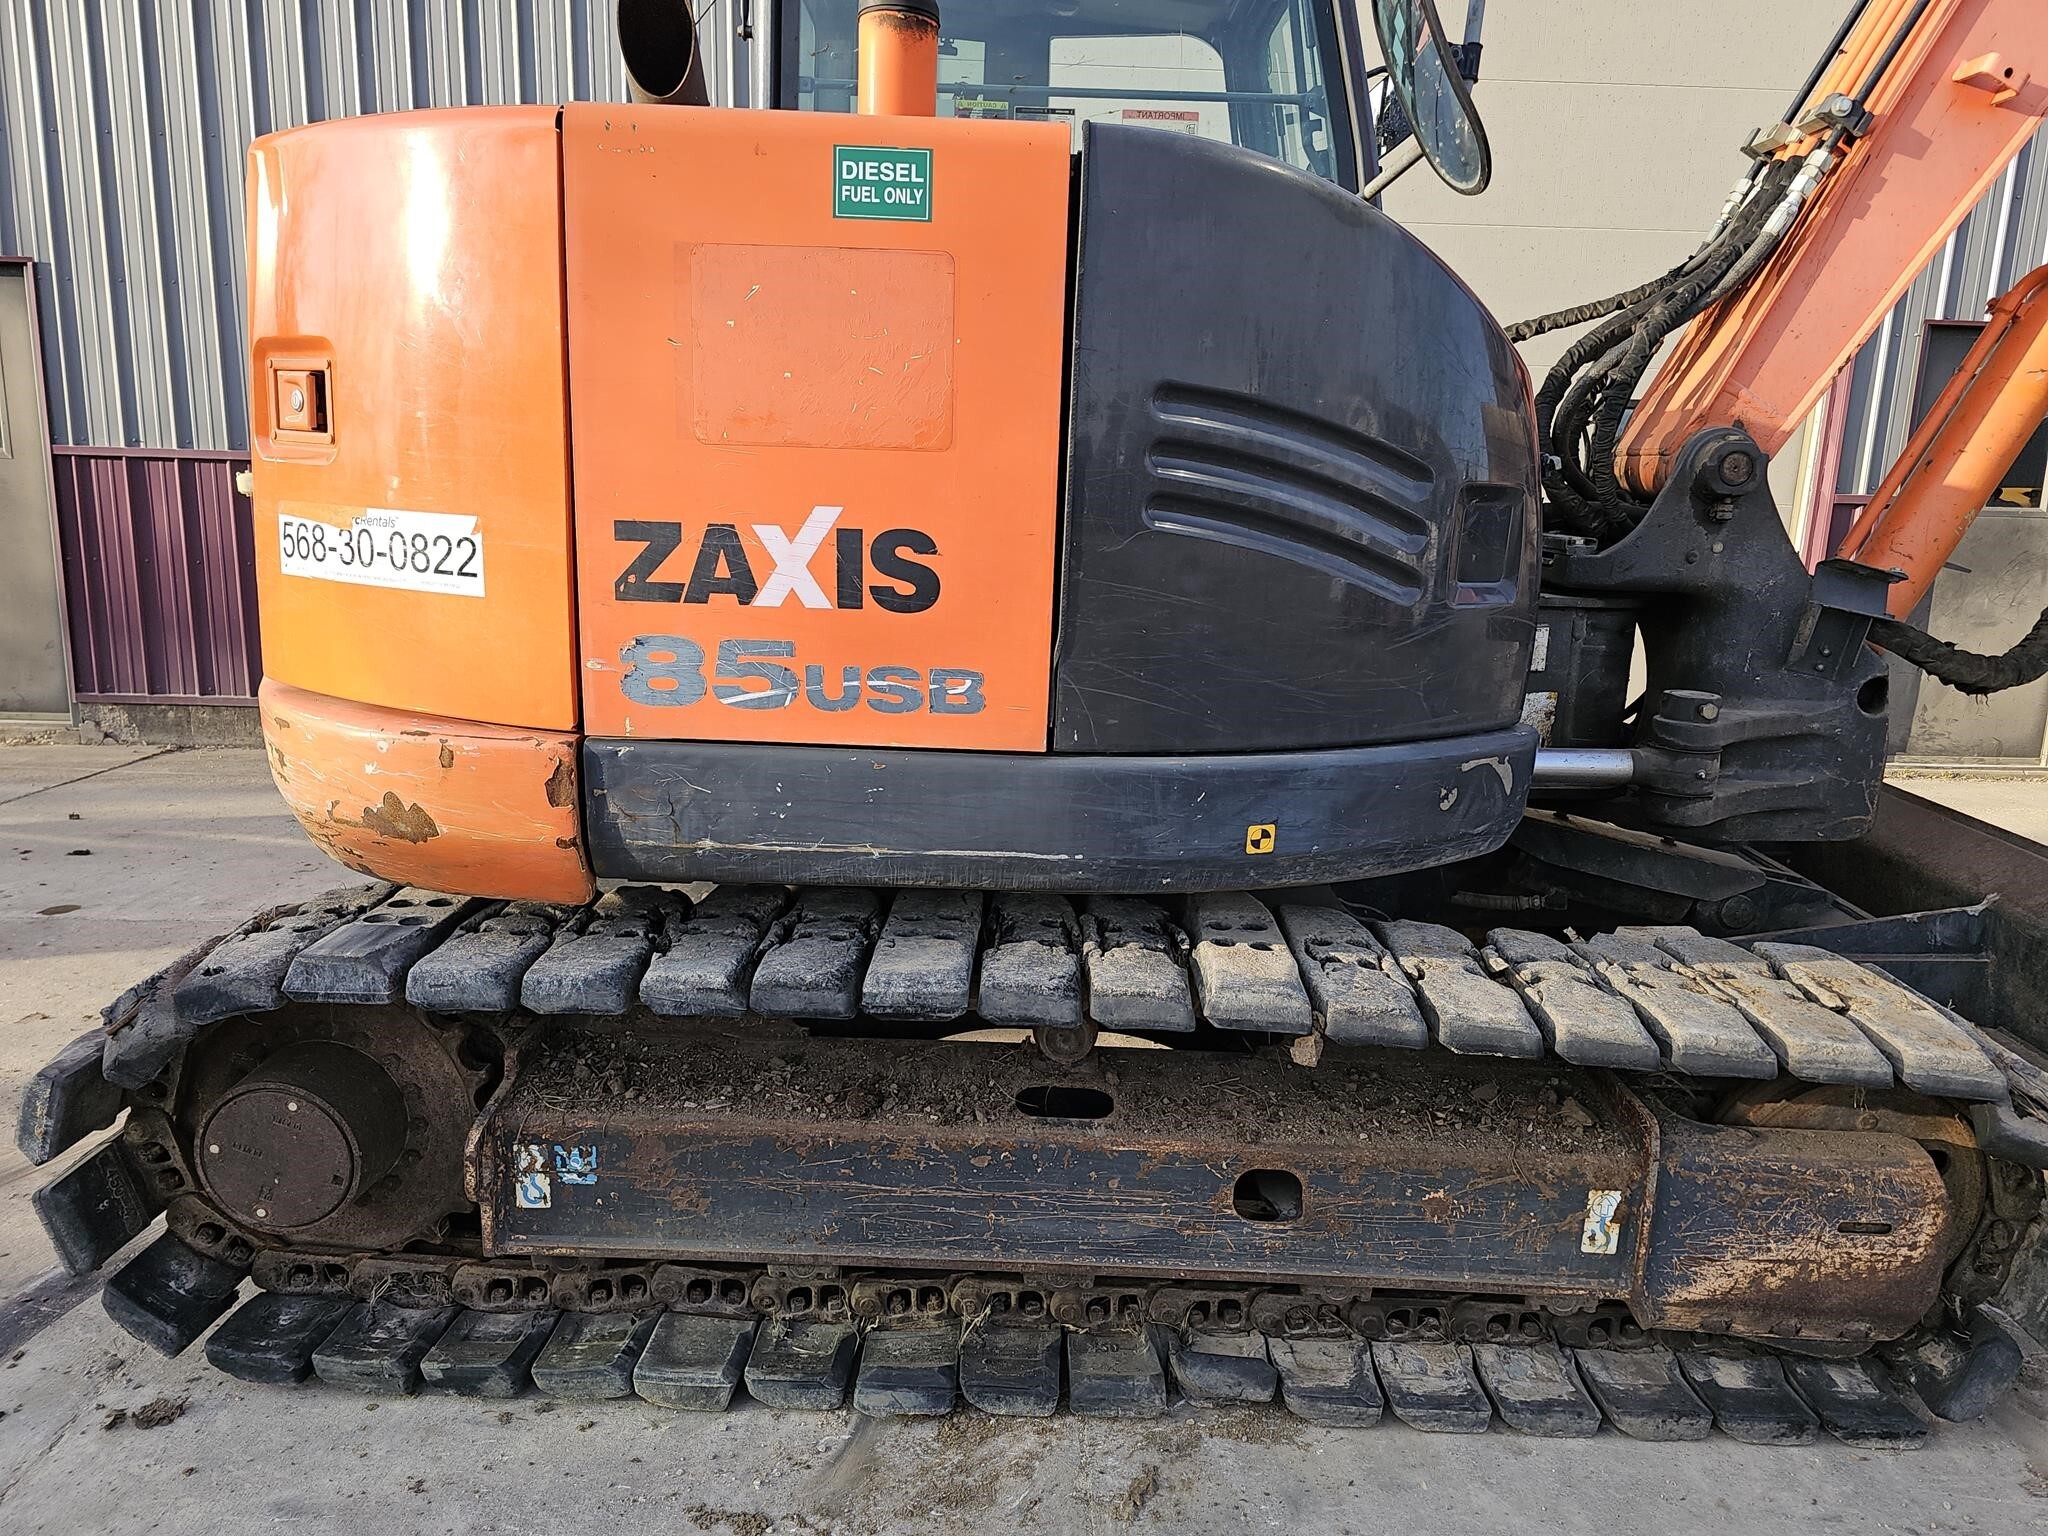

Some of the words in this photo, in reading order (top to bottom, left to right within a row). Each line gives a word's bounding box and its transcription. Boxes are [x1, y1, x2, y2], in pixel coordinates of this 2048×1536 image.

[841, 161, 925, 183] DIESEL
[841, 185, 880, 204] FUEL
[884, 187, 924, 206] ONLY
[283, 522, 477, 577] 568-30-0822
[614, 506, 941, 613] ZAXIS
